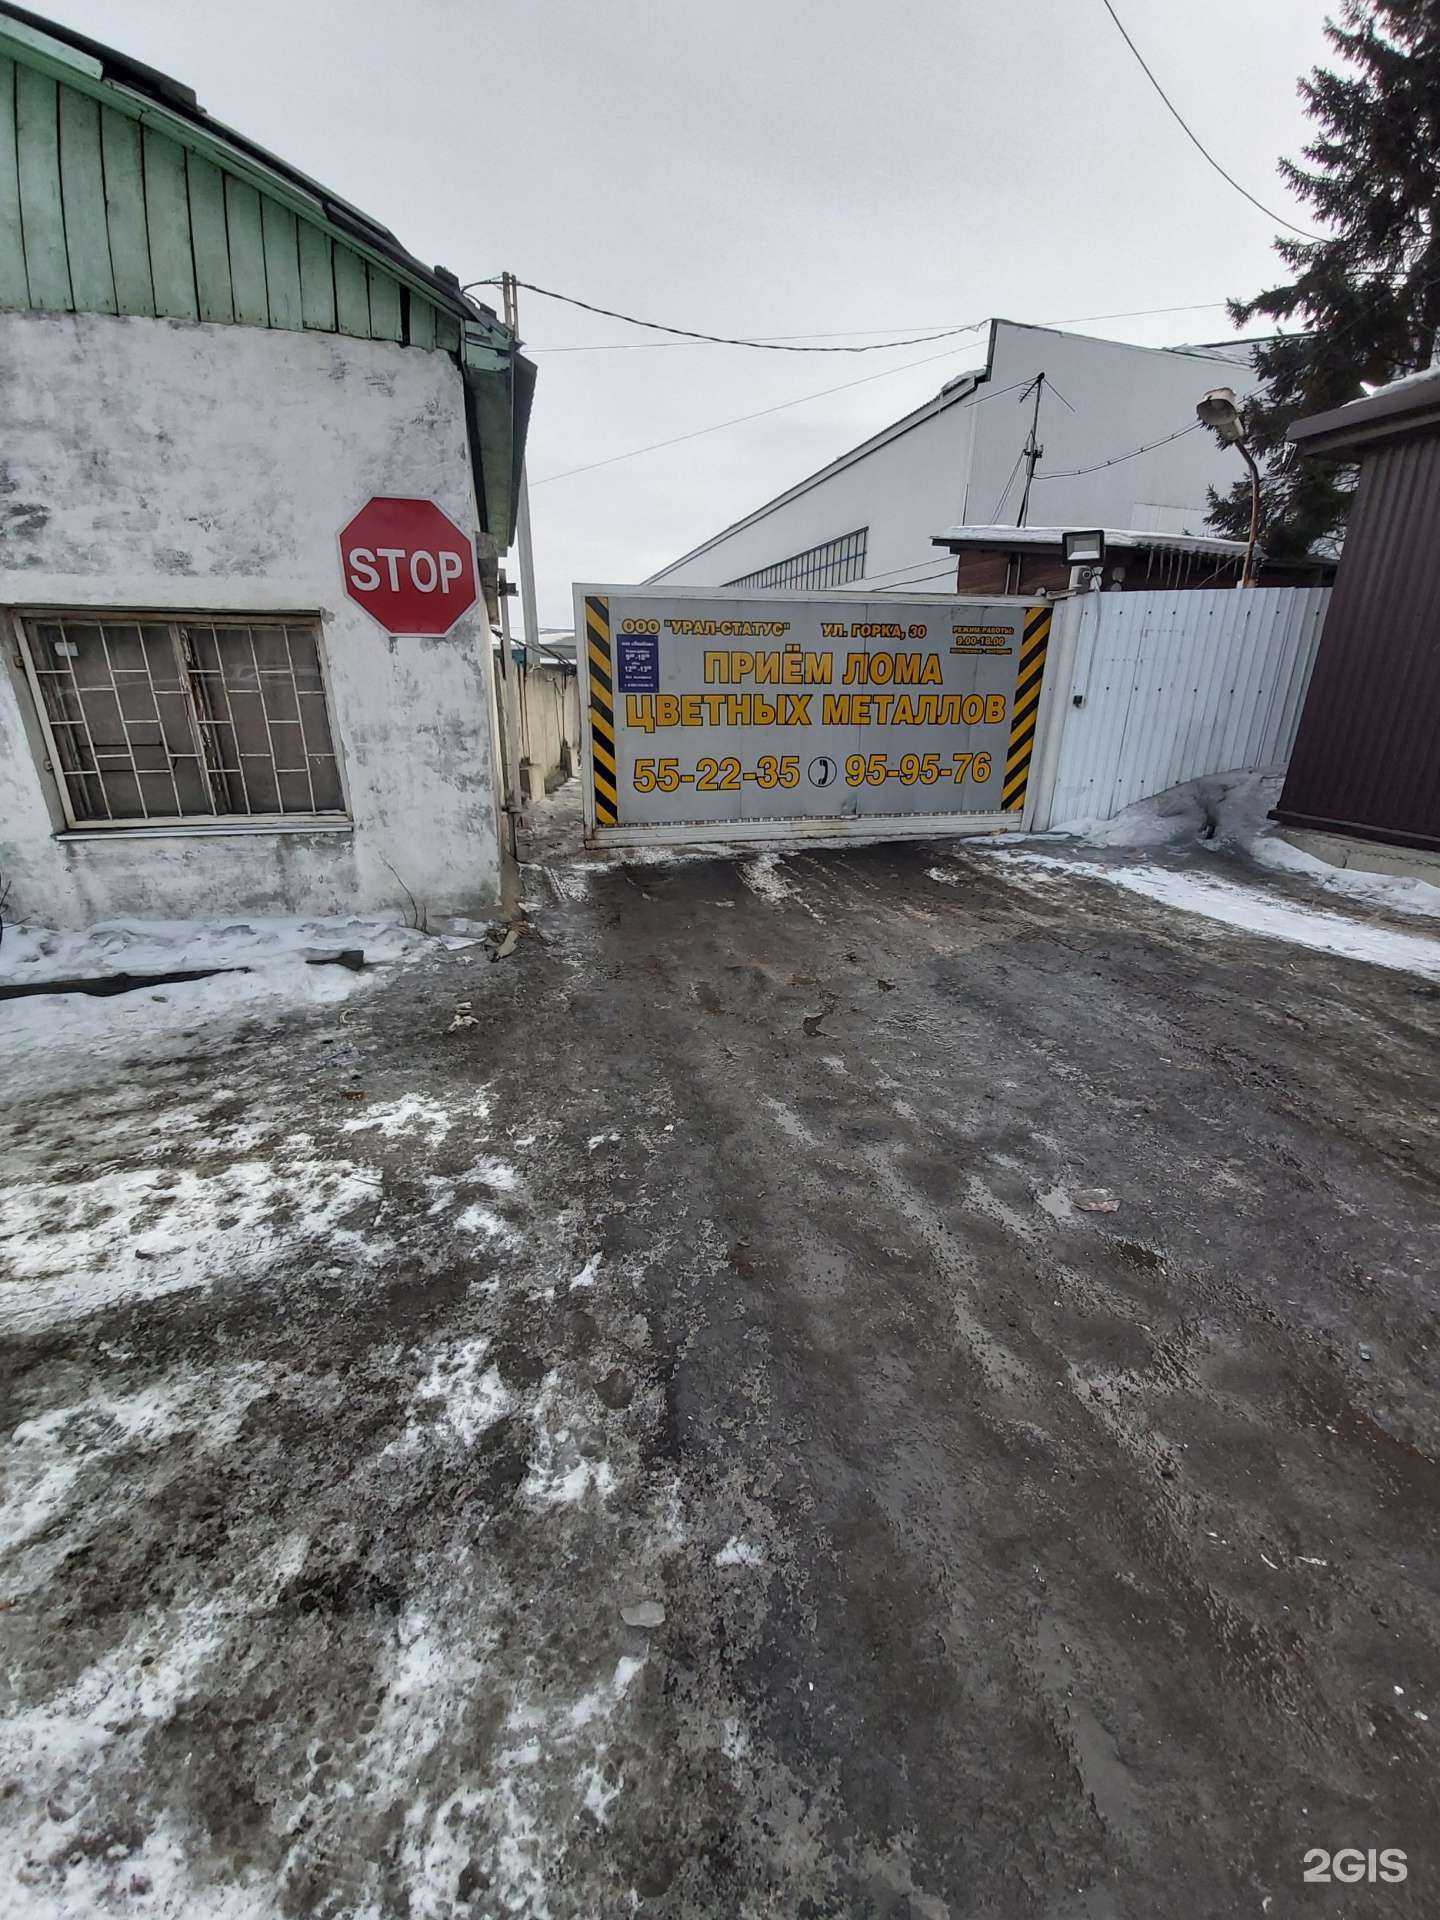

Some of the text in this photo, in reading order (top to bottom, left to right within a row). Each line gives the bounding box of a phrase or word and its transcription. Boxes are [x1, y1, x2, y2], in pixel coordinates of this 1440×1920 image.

[350, 547, 463, 594] STOP
[622, 619, 791, 636] ООО "УРАЛ-СТАТУС"
[821, 623, 927, 639] УЛ. ГОРКА, 30
[704, 644, 943, 685] ПРИЁМ ЛОМА
[625, 694, 1006, 733] ЦВЕТНЫХ МЕТАЛЛОВ
[633, 752, 991, 793] 55-22-35 95-95-76
